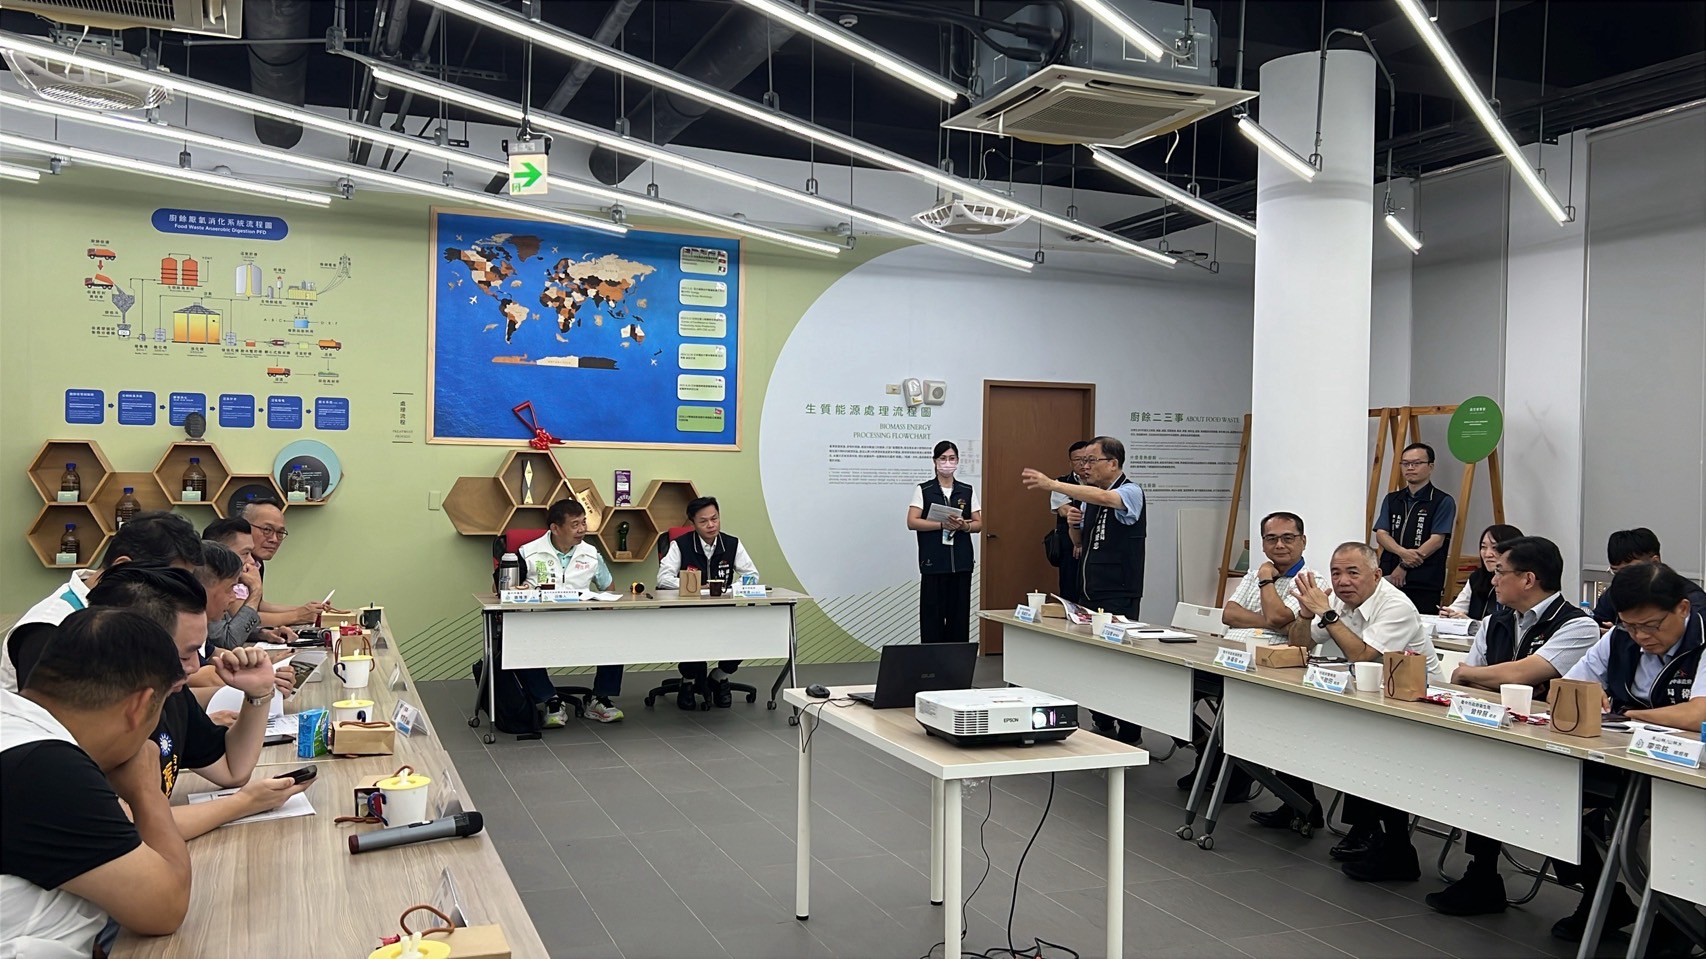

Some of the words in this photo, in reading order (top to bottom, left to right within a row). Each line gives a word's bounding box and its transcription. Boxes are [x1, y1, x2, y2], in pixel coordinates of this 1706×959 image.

[805, 403, 932, 418] 生質能源處理流程圖
[1130, 412, 1184, 422] 廚餘二三事
